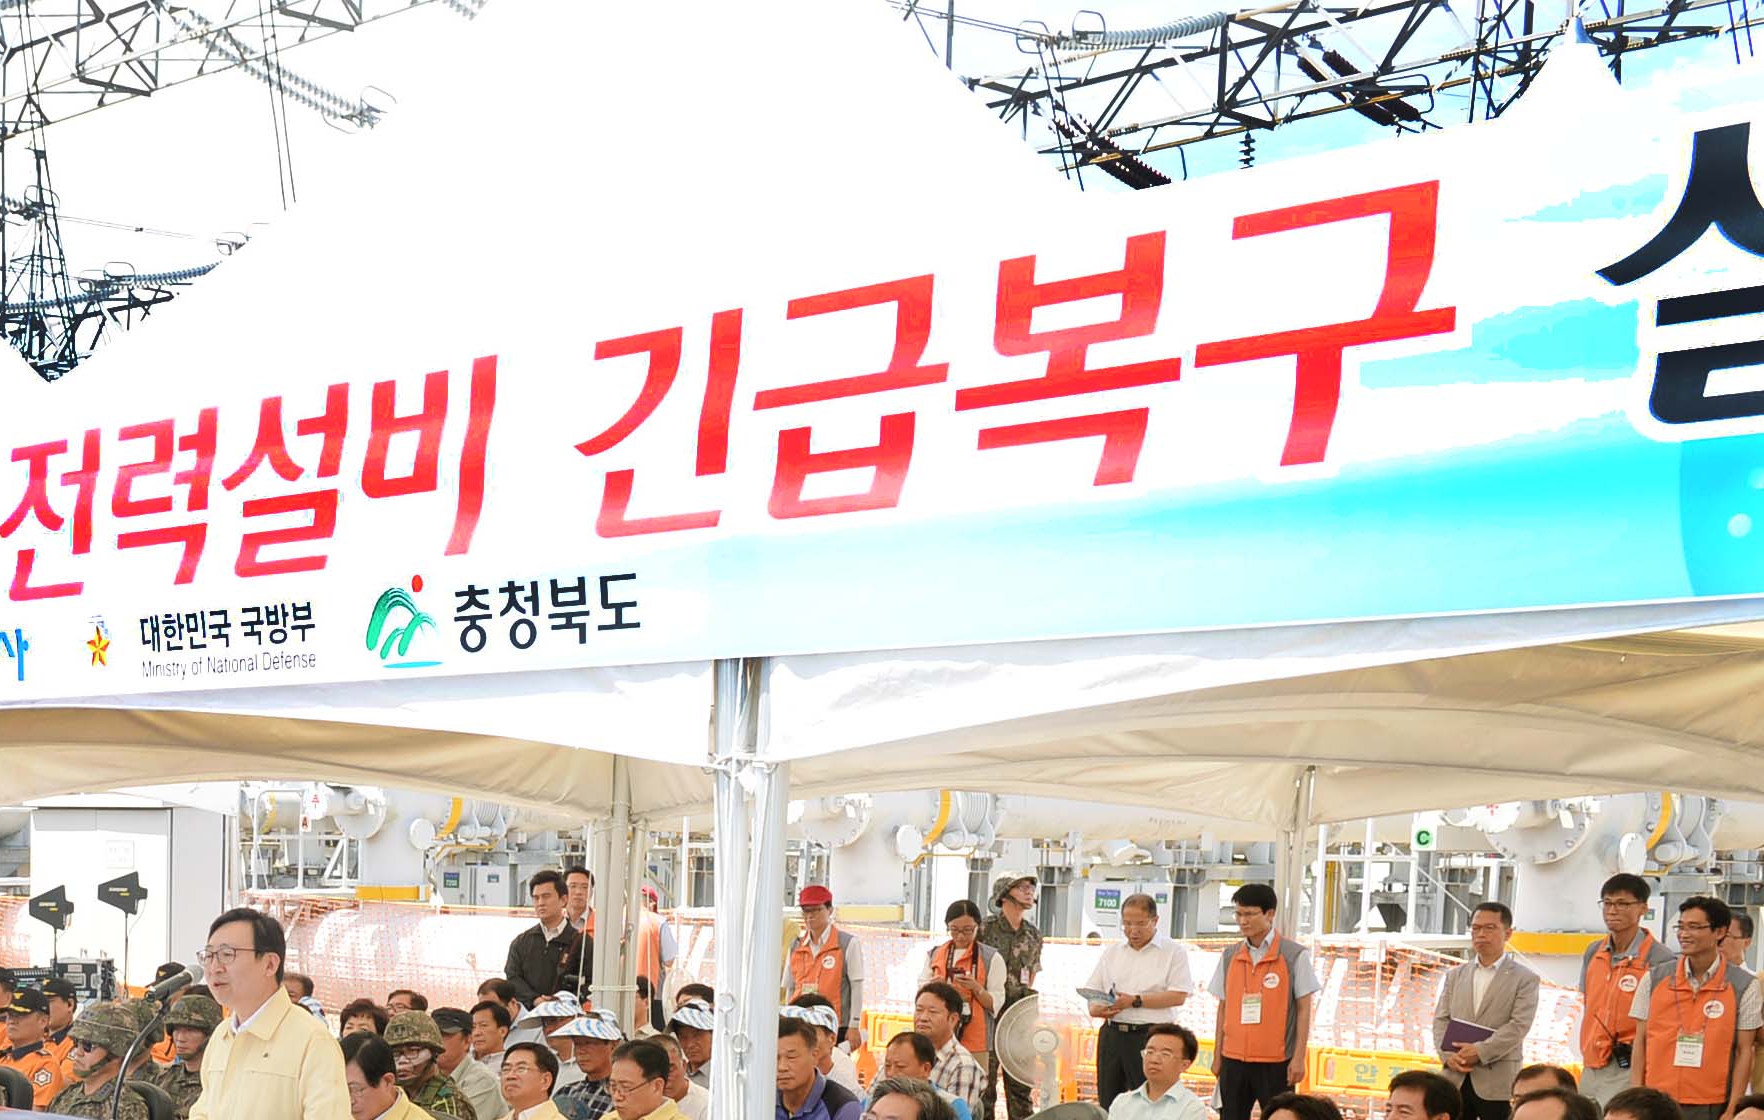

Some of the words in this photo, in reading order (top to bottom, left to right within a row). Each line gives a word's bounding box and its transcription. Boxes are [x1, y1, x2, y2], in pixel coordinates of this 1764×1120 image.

[574, 178, 1458, 540] 긴급복구
[139, 610, 232, 653] 대한민국
[240, 601, 316, 646] 국방부
[453, 571, 642, 653] 충청북도
[141, 660, 186, 681] Ministry
[191, 659, 204, 676] of
[207, 654, 259, 674] National
[262, 650, 317, 671] Defense
[1416, 830, 1430, 846] C
